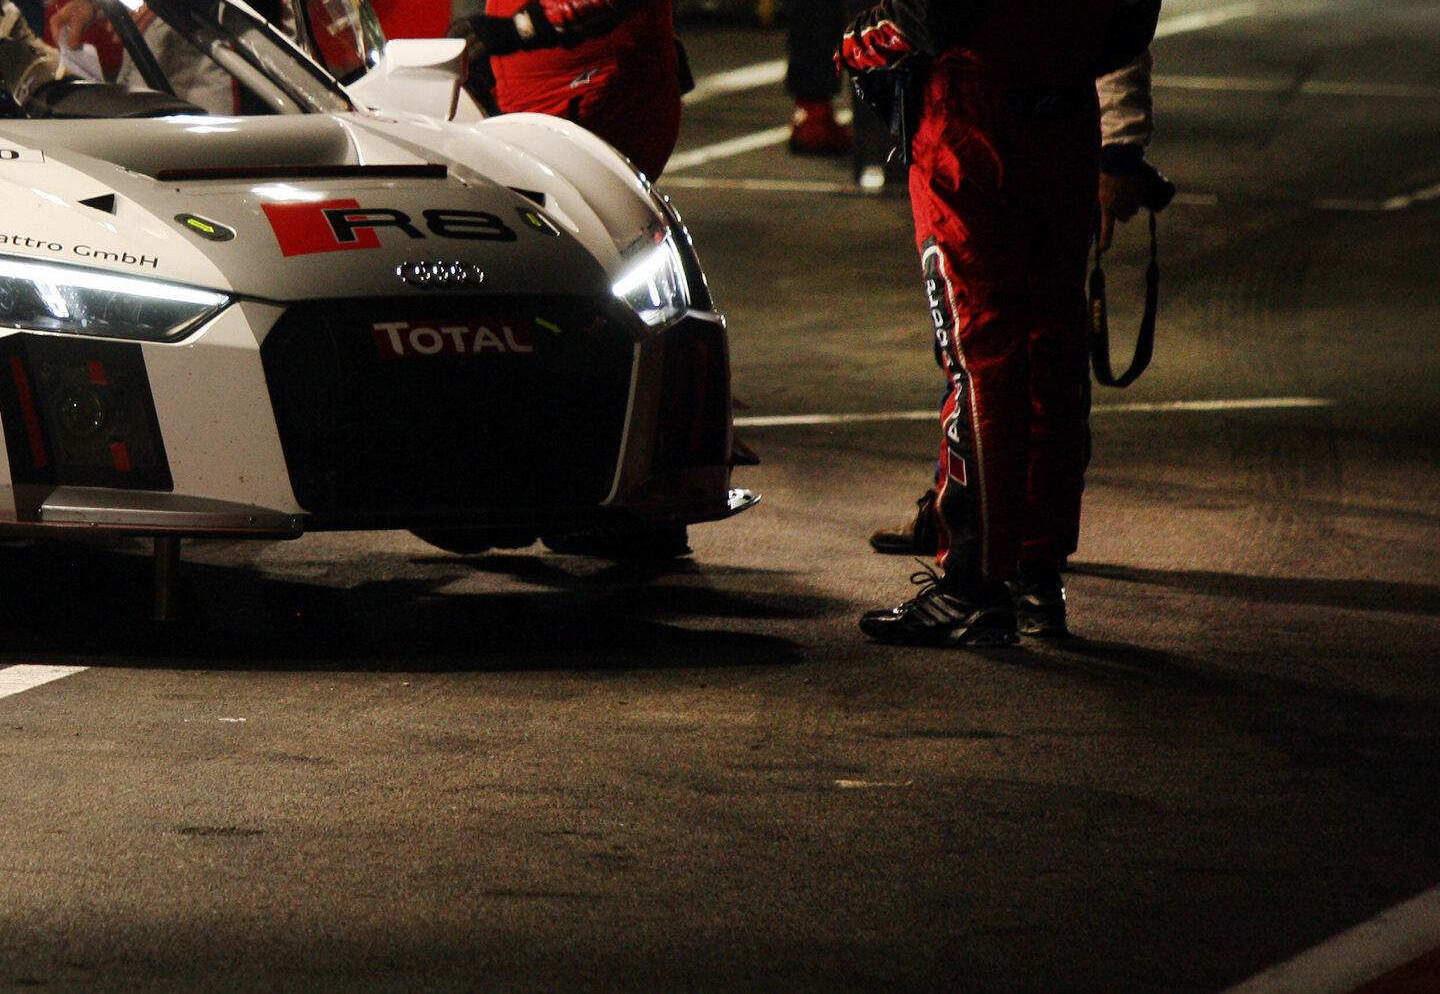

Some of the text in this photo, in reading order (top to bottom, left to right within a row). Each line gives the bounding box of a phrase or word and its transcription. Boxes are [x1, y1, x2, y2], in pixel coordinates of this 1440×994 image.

[322, 208, 517, 242] R8
[73, 245, 159, 269] GmbH
[374, 321, 534, 355] TOTAL
